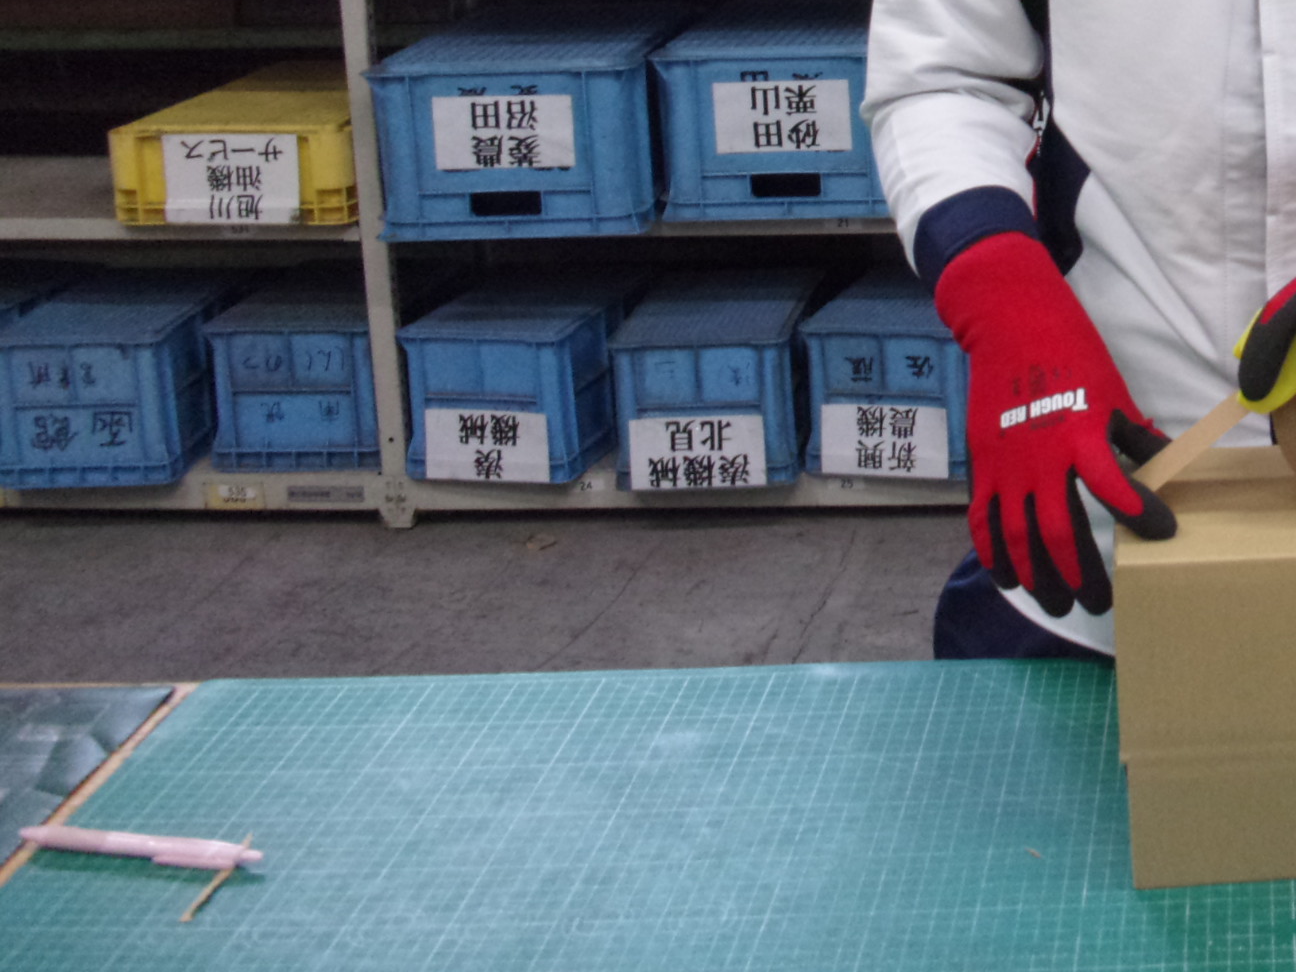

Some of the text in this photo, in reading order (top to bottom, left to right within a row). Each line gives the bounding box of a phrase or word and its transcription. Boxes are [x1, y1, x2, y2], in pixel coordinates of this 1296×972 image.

[750, 85, 818, 115] 栗山
[471, 100, 540, 131] 沼田
[180, 138, 284, 164] サービス
[206, 165, 263, 191] 油機
[208, 193, 264, 220] 旭川
[1000, 404, 1026, 428] RED
[1028, 388, 1089, 419] TOUGH
[458, 413, 520, 446] 機械
[665, 421, 732, 453] 北見
[855, 407, 918, 437] 農機
[855, 441, 918, 473] 新興
